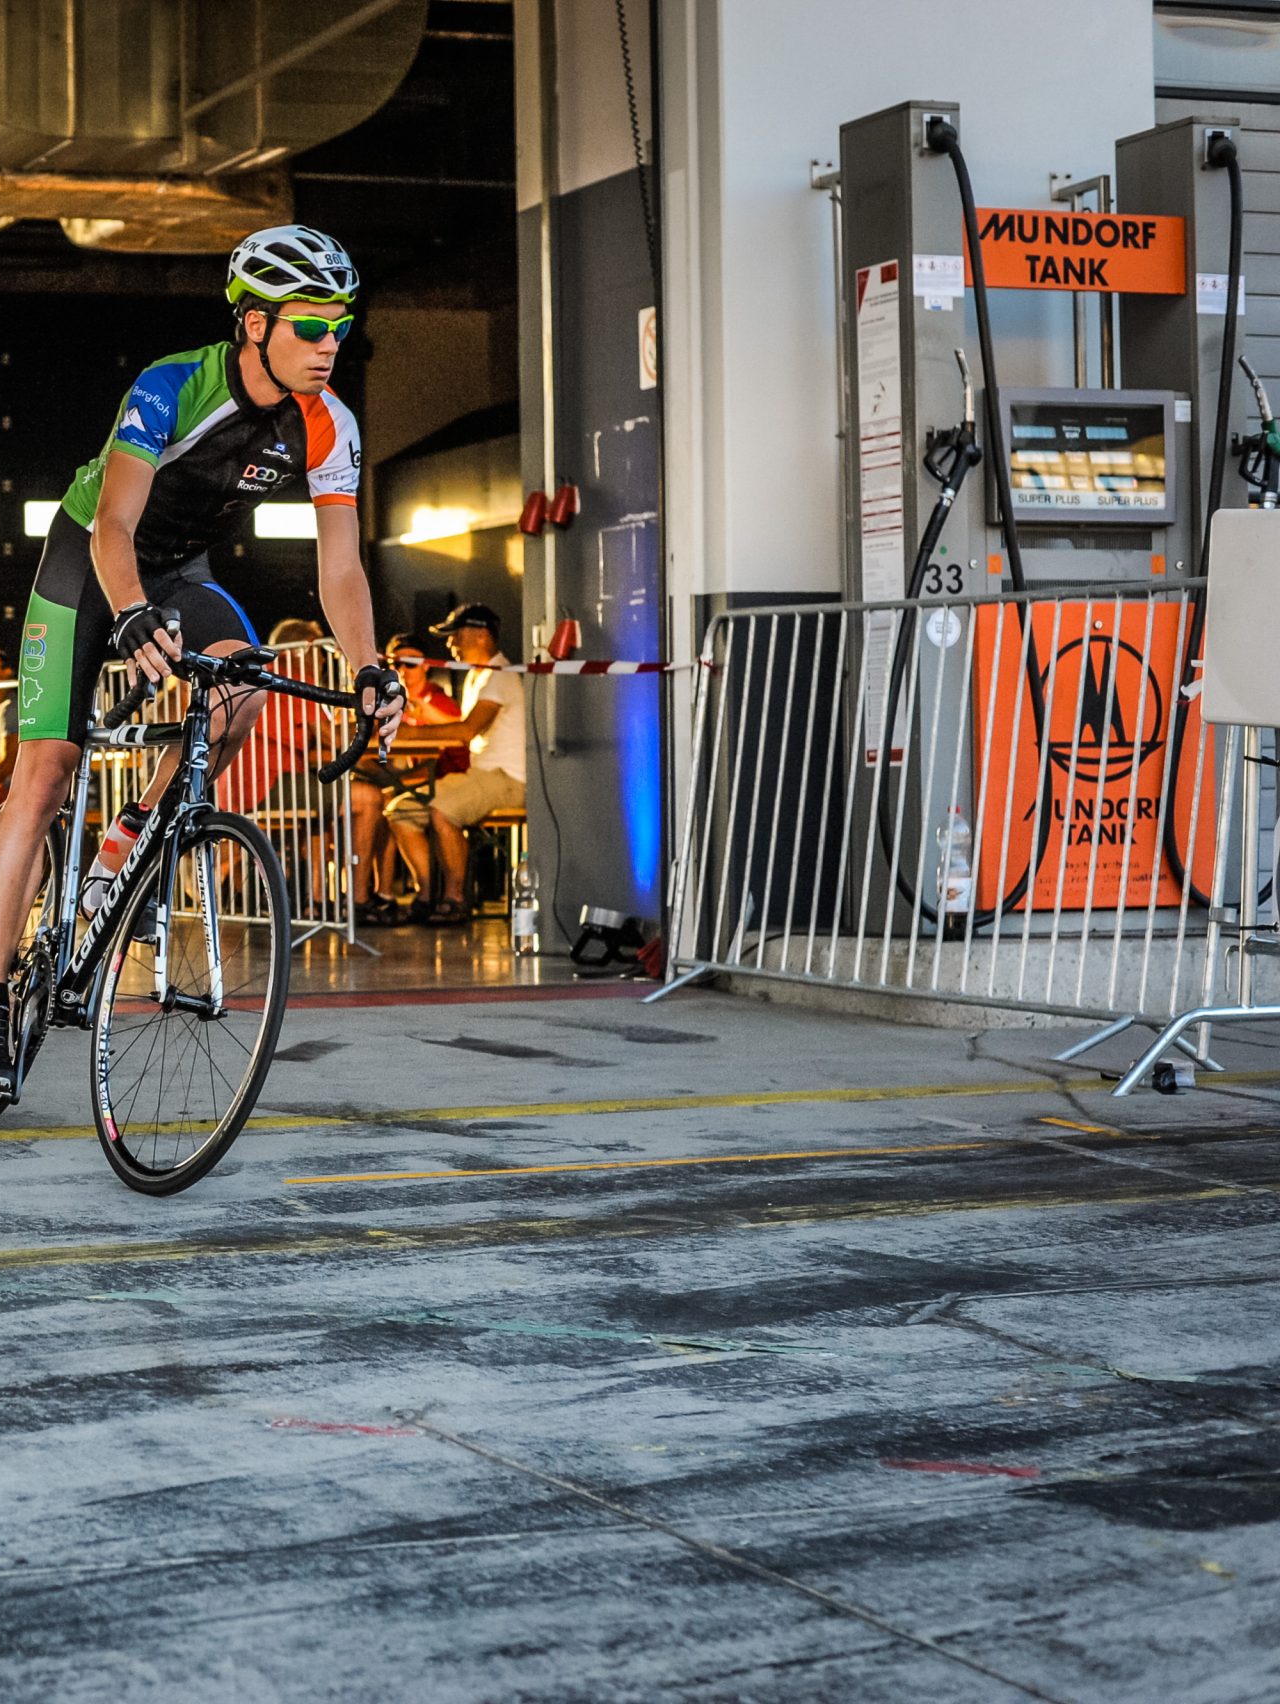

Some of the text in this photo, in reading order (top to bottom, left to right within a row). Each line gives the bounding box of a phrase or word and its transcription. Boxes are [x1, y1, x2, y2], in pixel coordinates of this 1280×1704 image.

[979, 213, 1156, 249] MUNDORF
[1025, 255, 1109, 286] TANK
[132, 386, 170, 417] Bergfloh
[1018, 494, 1081, 505] SUPER PLUS
[1097, 496, 1159, 507] SUPER PLUS
[926, 564, 964, 595] 33
[1062, 823, 1136, 845] TANK
